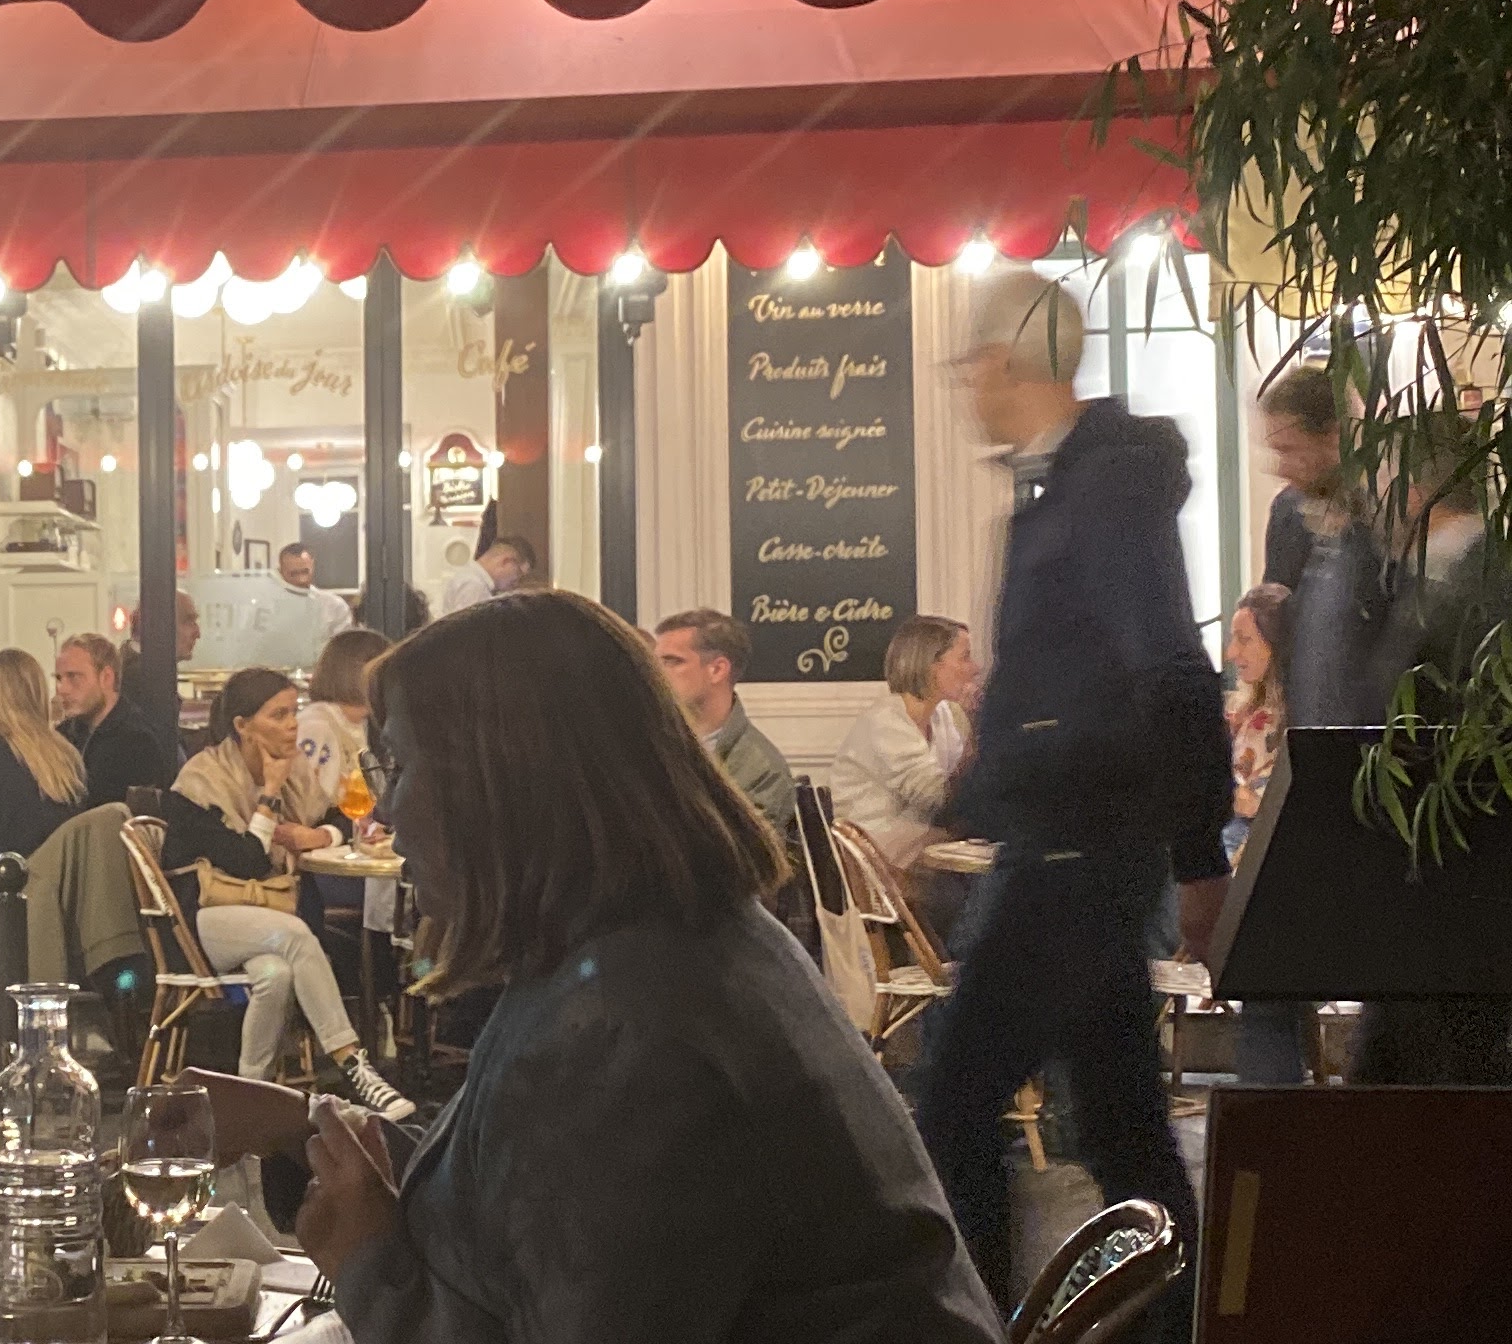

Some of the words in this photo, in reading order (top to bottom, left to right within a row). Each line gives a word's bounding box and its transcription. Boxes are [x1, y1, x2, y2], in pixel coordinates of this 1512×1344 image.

[748, 294, 796, 323] Vin
[798, 306, 825, 319] au
[826, 301, 885, 318] verre
[458, 339, 537, 392] Café
[748, 352, 830, 381] Produits
[830, 354, 887, 400] frais
[741, 416, 812, 442] Cuisine
[816, 418, 886, 450] soignée
[750, 594, 809, 622] Bière
[832, 597, 893, 622] Cidre
